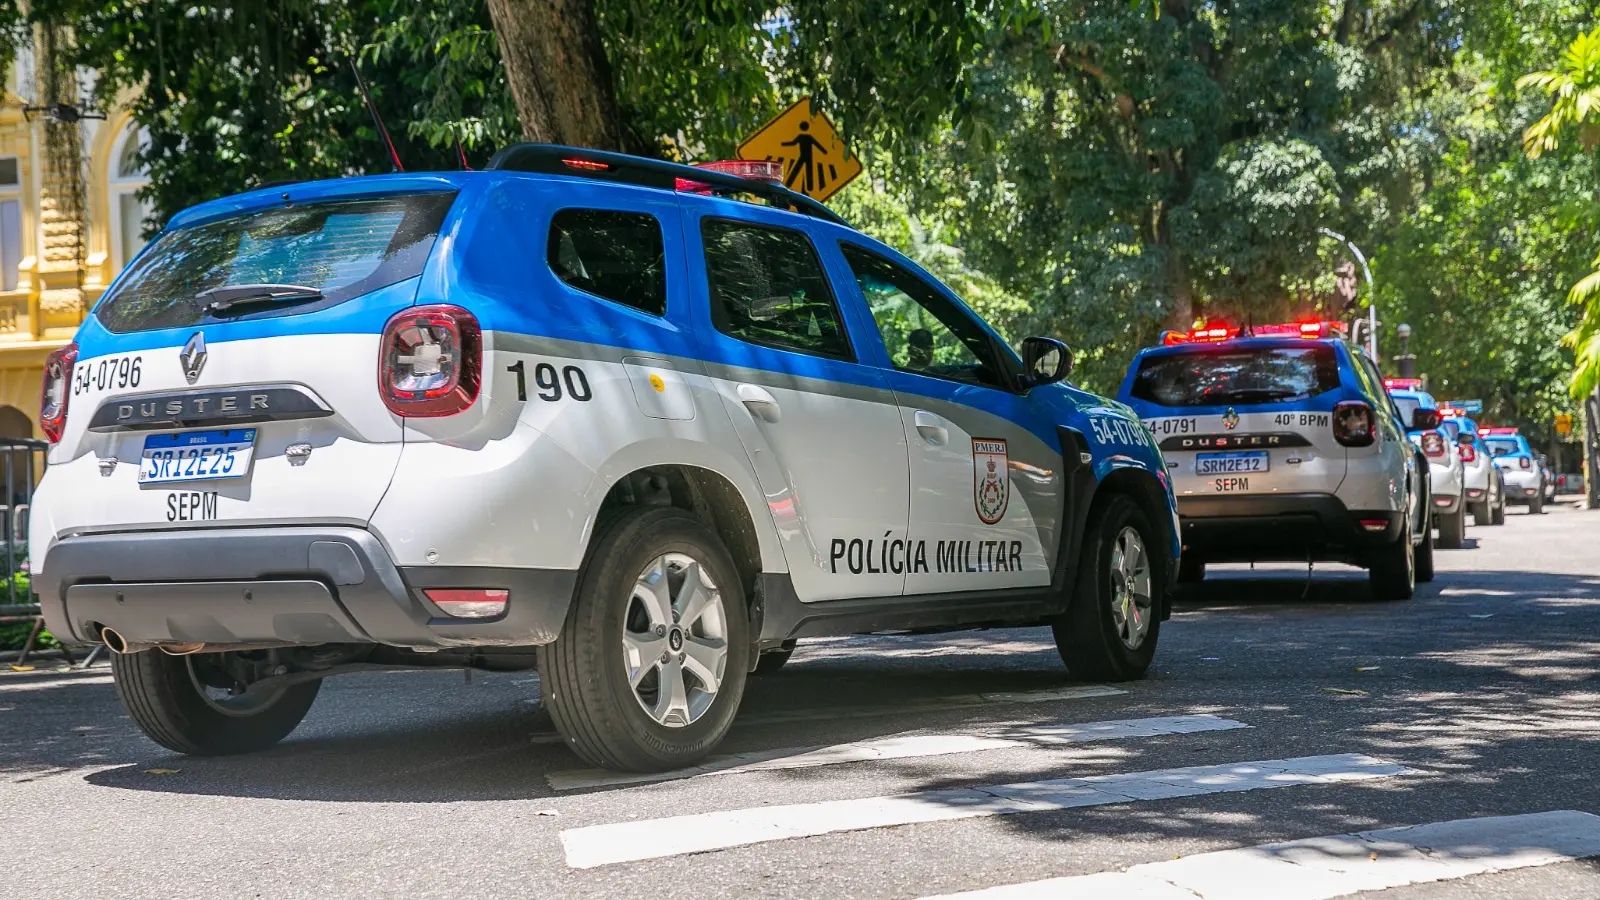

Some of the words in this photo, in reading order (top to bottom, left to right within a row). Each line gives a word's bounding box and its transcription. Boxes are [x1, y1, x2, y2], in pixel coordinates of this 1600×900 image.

[74, 356, 142, 395] 54-0796
[506, 360, 592, 401] 190
[117, 394, 269, 420] DUSTER
[1143, 418, 1196, 435] 4-0791
[1300, 414, 1328, 427] BPM
[975, 443, 1004, 452] PMERJ
[1182, 437, 1279, 447] DUSTER
[148, 447, 237, 478] SRI2E25
[1203, 459, 1260, 473] SRM2E12
[1216, 478, 1249, 491] SEPM
[167, 492, 218, 522] SEPM
[830, 530, 929, 574] POLÍCIA
[936, 540, 1022, 573] MILITAR
